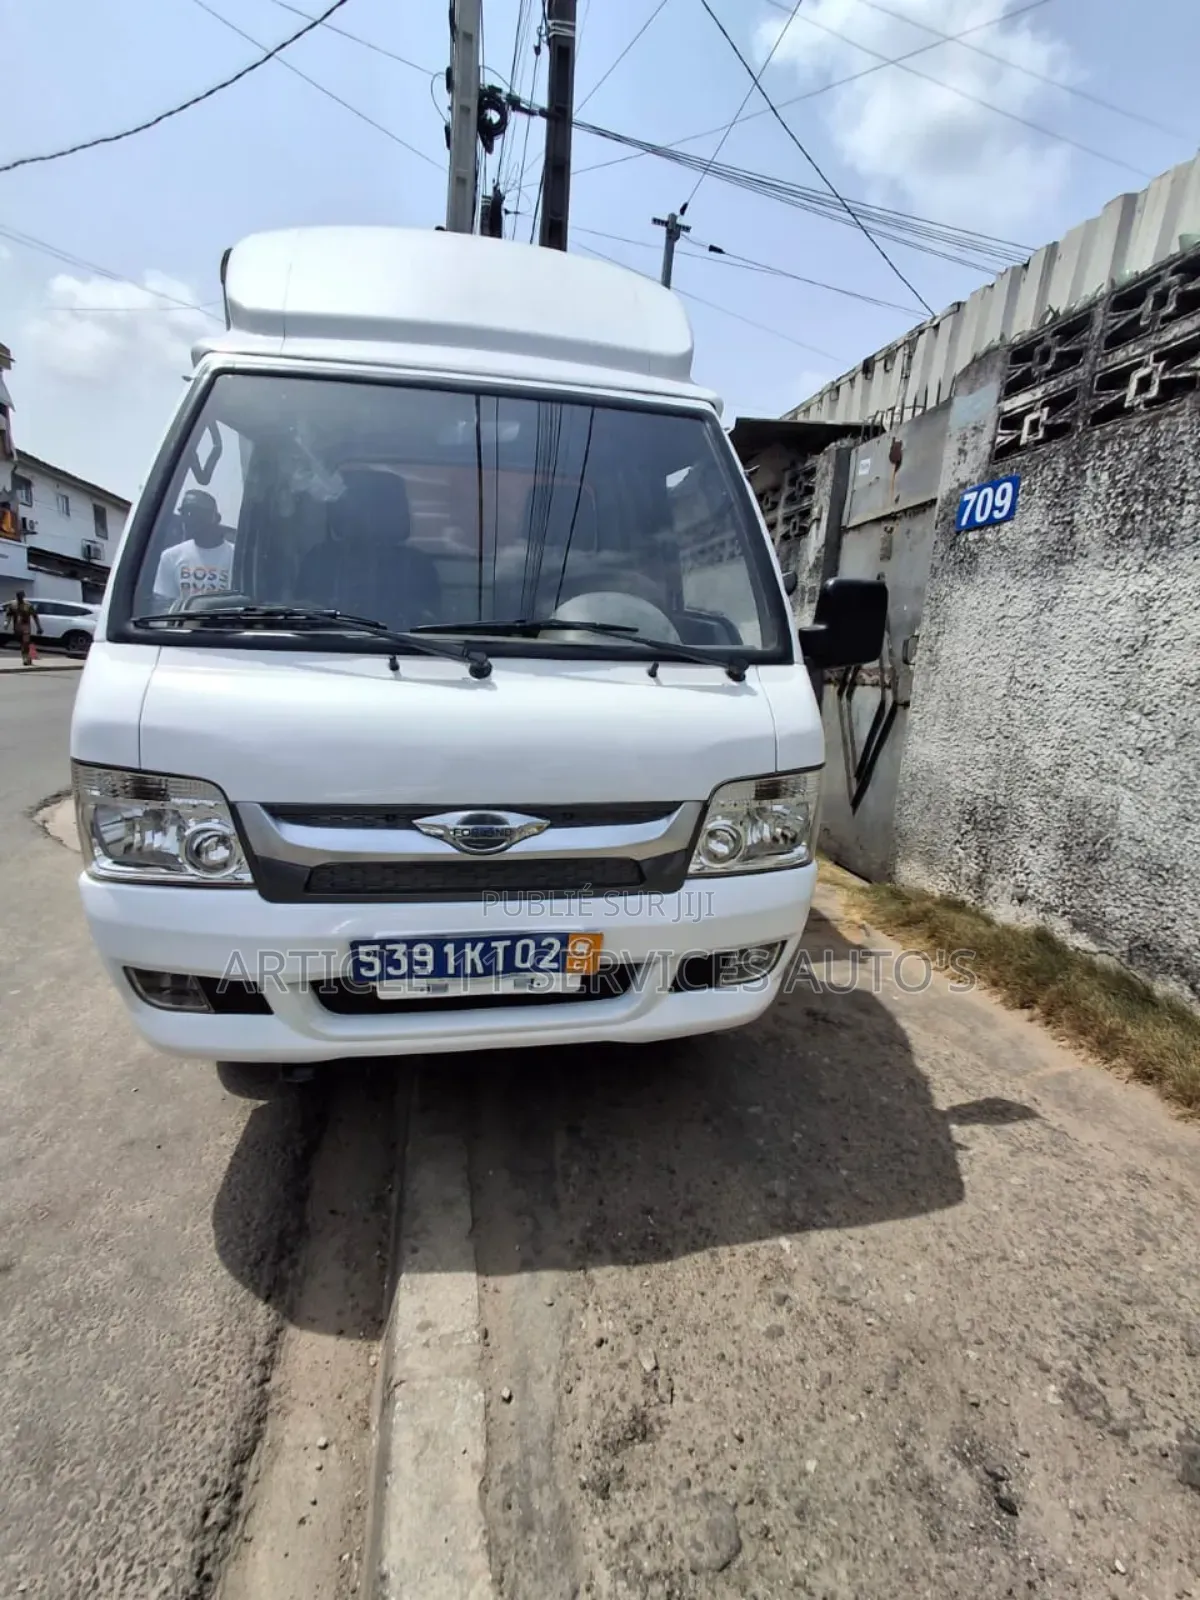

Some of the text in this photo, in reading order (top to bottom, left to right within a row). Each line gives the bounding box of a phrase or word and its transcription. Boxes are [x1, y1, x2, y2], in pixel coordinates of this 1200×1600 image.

[961, 482, 1013, 526] 709
[180, 566, 229, 582] BOSS
[358, 937, 561, 977] 5391KT02
